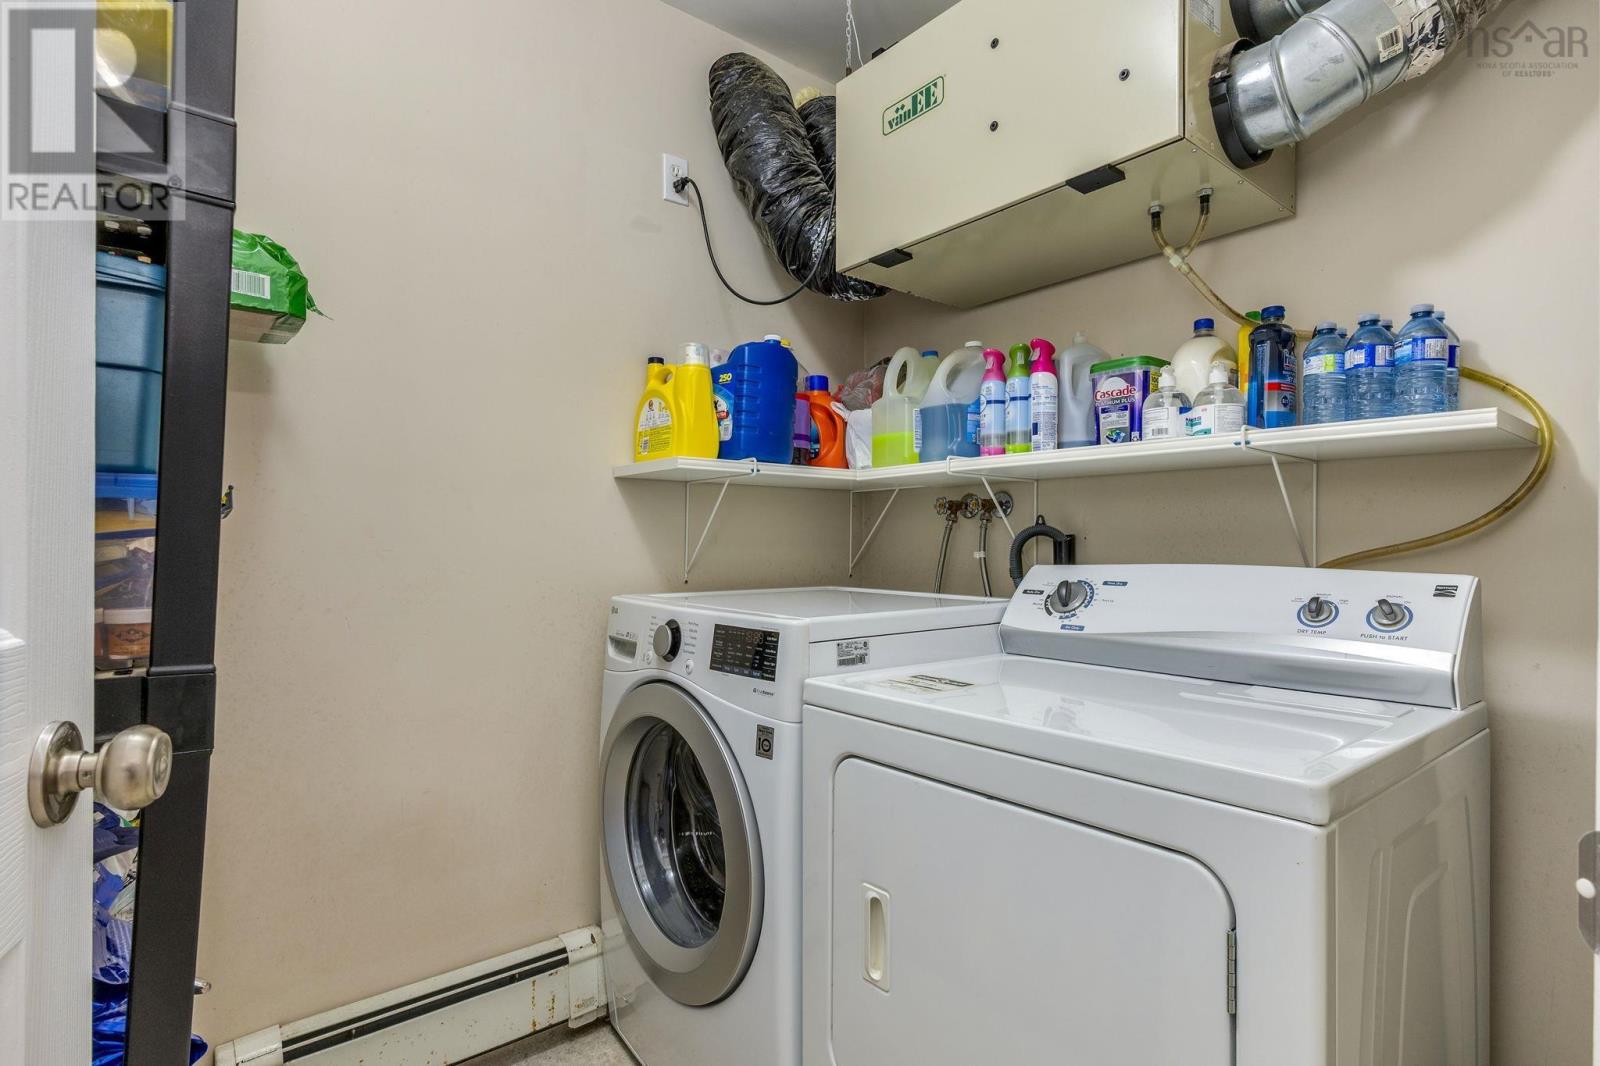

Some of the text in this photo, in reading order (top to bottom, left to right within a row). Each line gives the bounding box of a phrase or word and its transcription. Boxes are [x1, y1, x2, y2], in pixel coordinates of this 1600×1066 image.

[718, 372, 733, 383] 250
[1094, 385, 1137, 402] Cascade
[1095, 396, 1136, 407] PLATINUM PLUS
